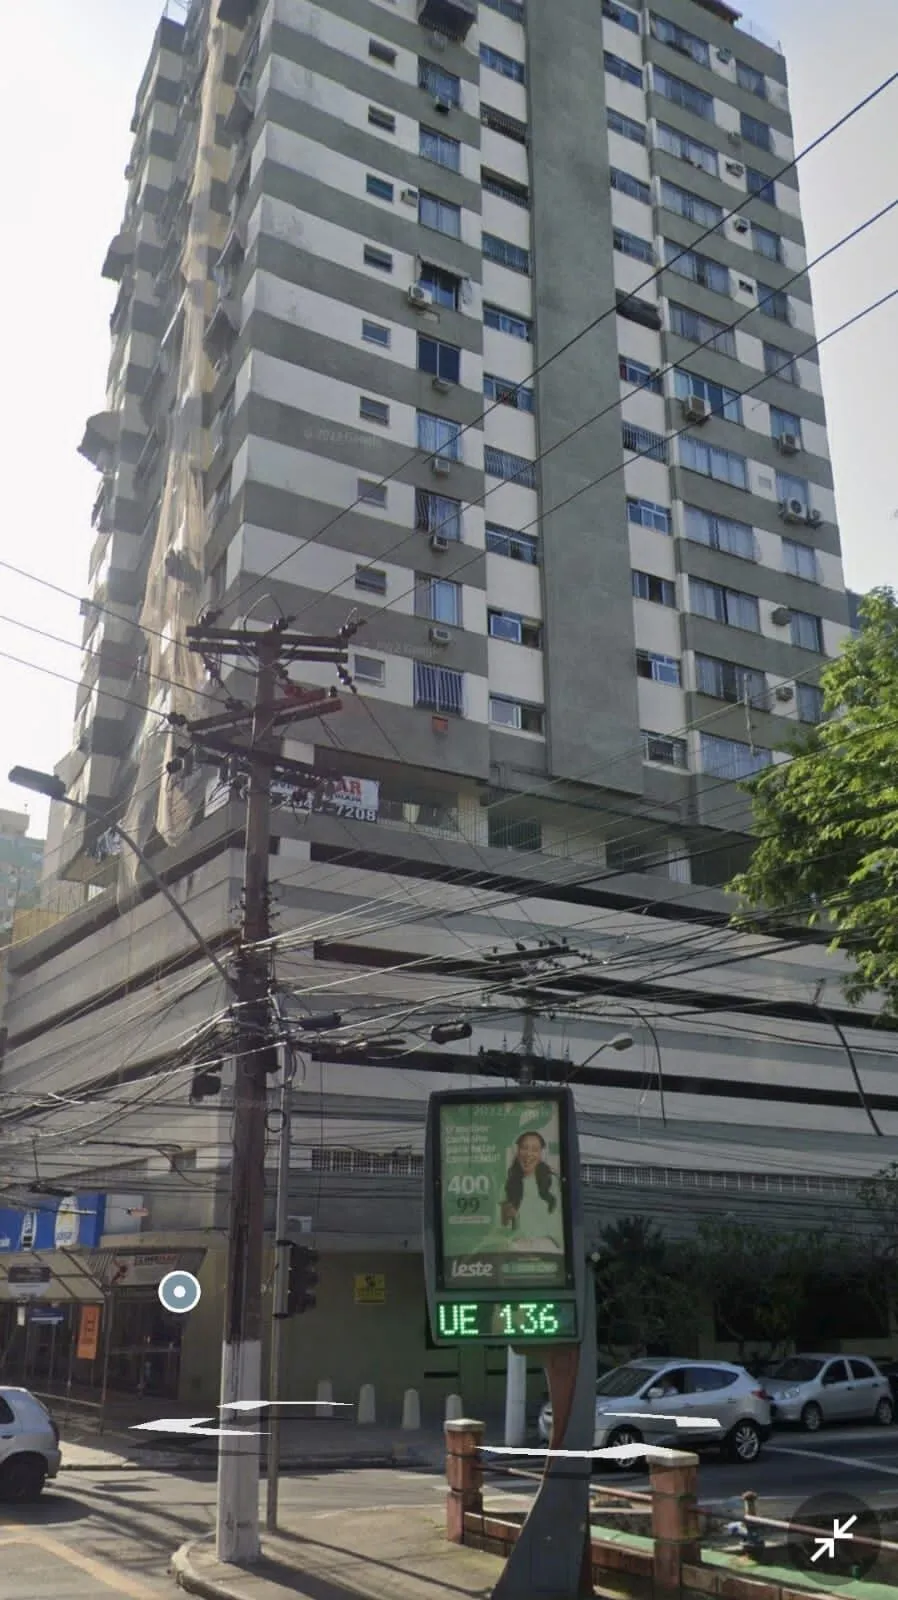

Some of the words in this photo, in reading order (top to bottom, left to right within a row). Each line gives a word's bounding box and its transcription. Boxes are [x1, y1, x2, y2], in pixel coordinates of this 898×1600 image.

[448, 1175, 490, 1195] 400
[439, 1304, 479, 1335] UE
[499, 1303, 559, 1334] 136
